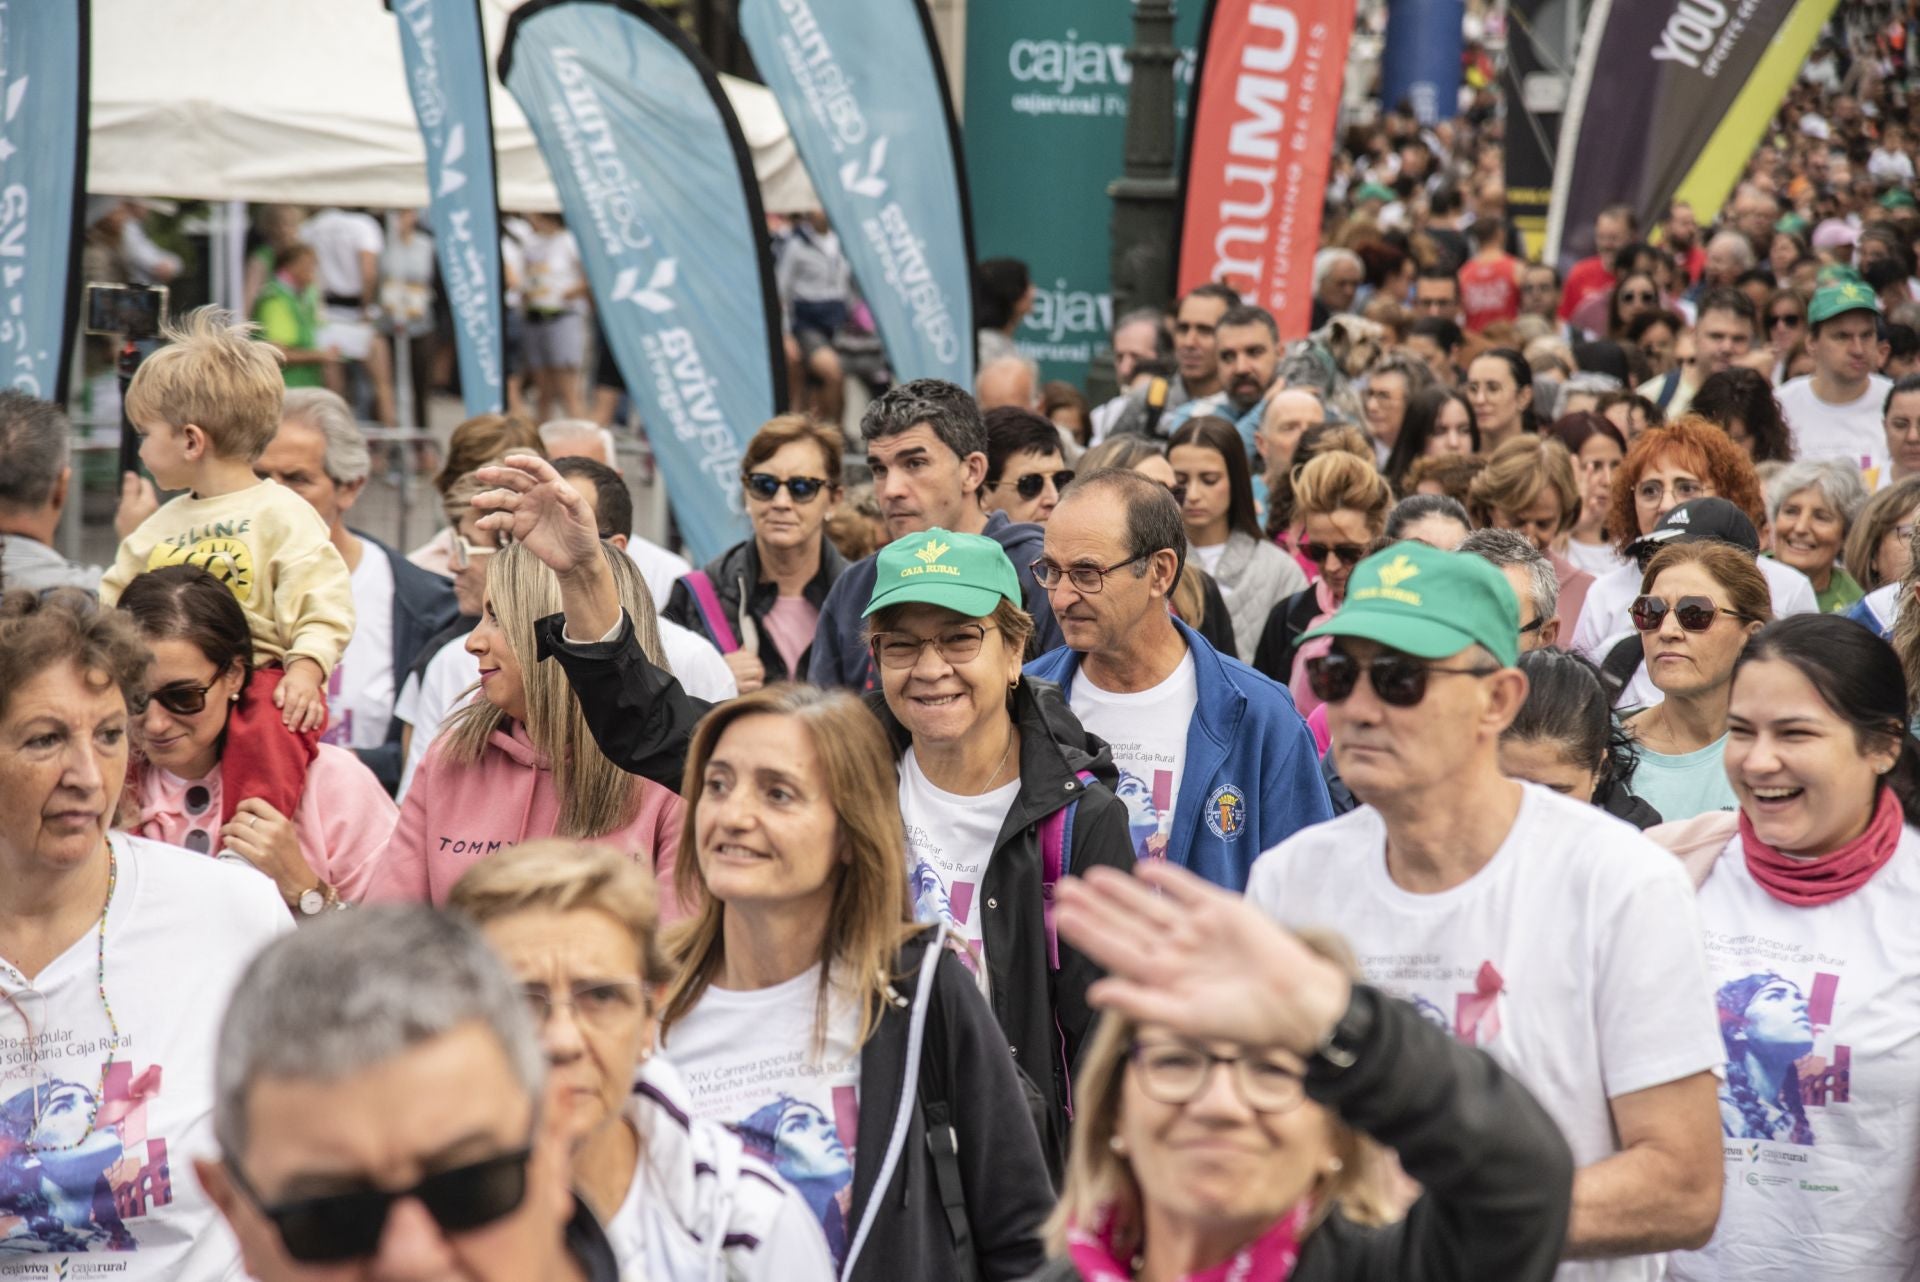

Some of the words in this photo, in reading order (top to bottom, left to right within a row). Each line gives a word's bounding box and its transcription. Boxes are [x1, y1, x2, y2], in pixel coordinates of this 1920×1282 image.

[900, 565, 924, 577] CAJA
[926, 564, 960, 576] RURAL
[1113, 751, 1133, 761] daria
[1135, 752, 1153, 763] Caja
[1154, 754, 1176, 764] Rural
[440, 837, 513, 854] TOMM
[955, 863, 979, 873] Rural
[65, 1040, 96, 1058] Caja
[99, 1034, 132, 1051] Rural
[713, 1059, 757, 1079] Carrera
[759, 1050, 805, 1071] popular
[699, 1077, 744, 1096] Marcha
[2, 1262, 49, 1276] cajaviva
[71, 1261, 127, 1276] cajarural
